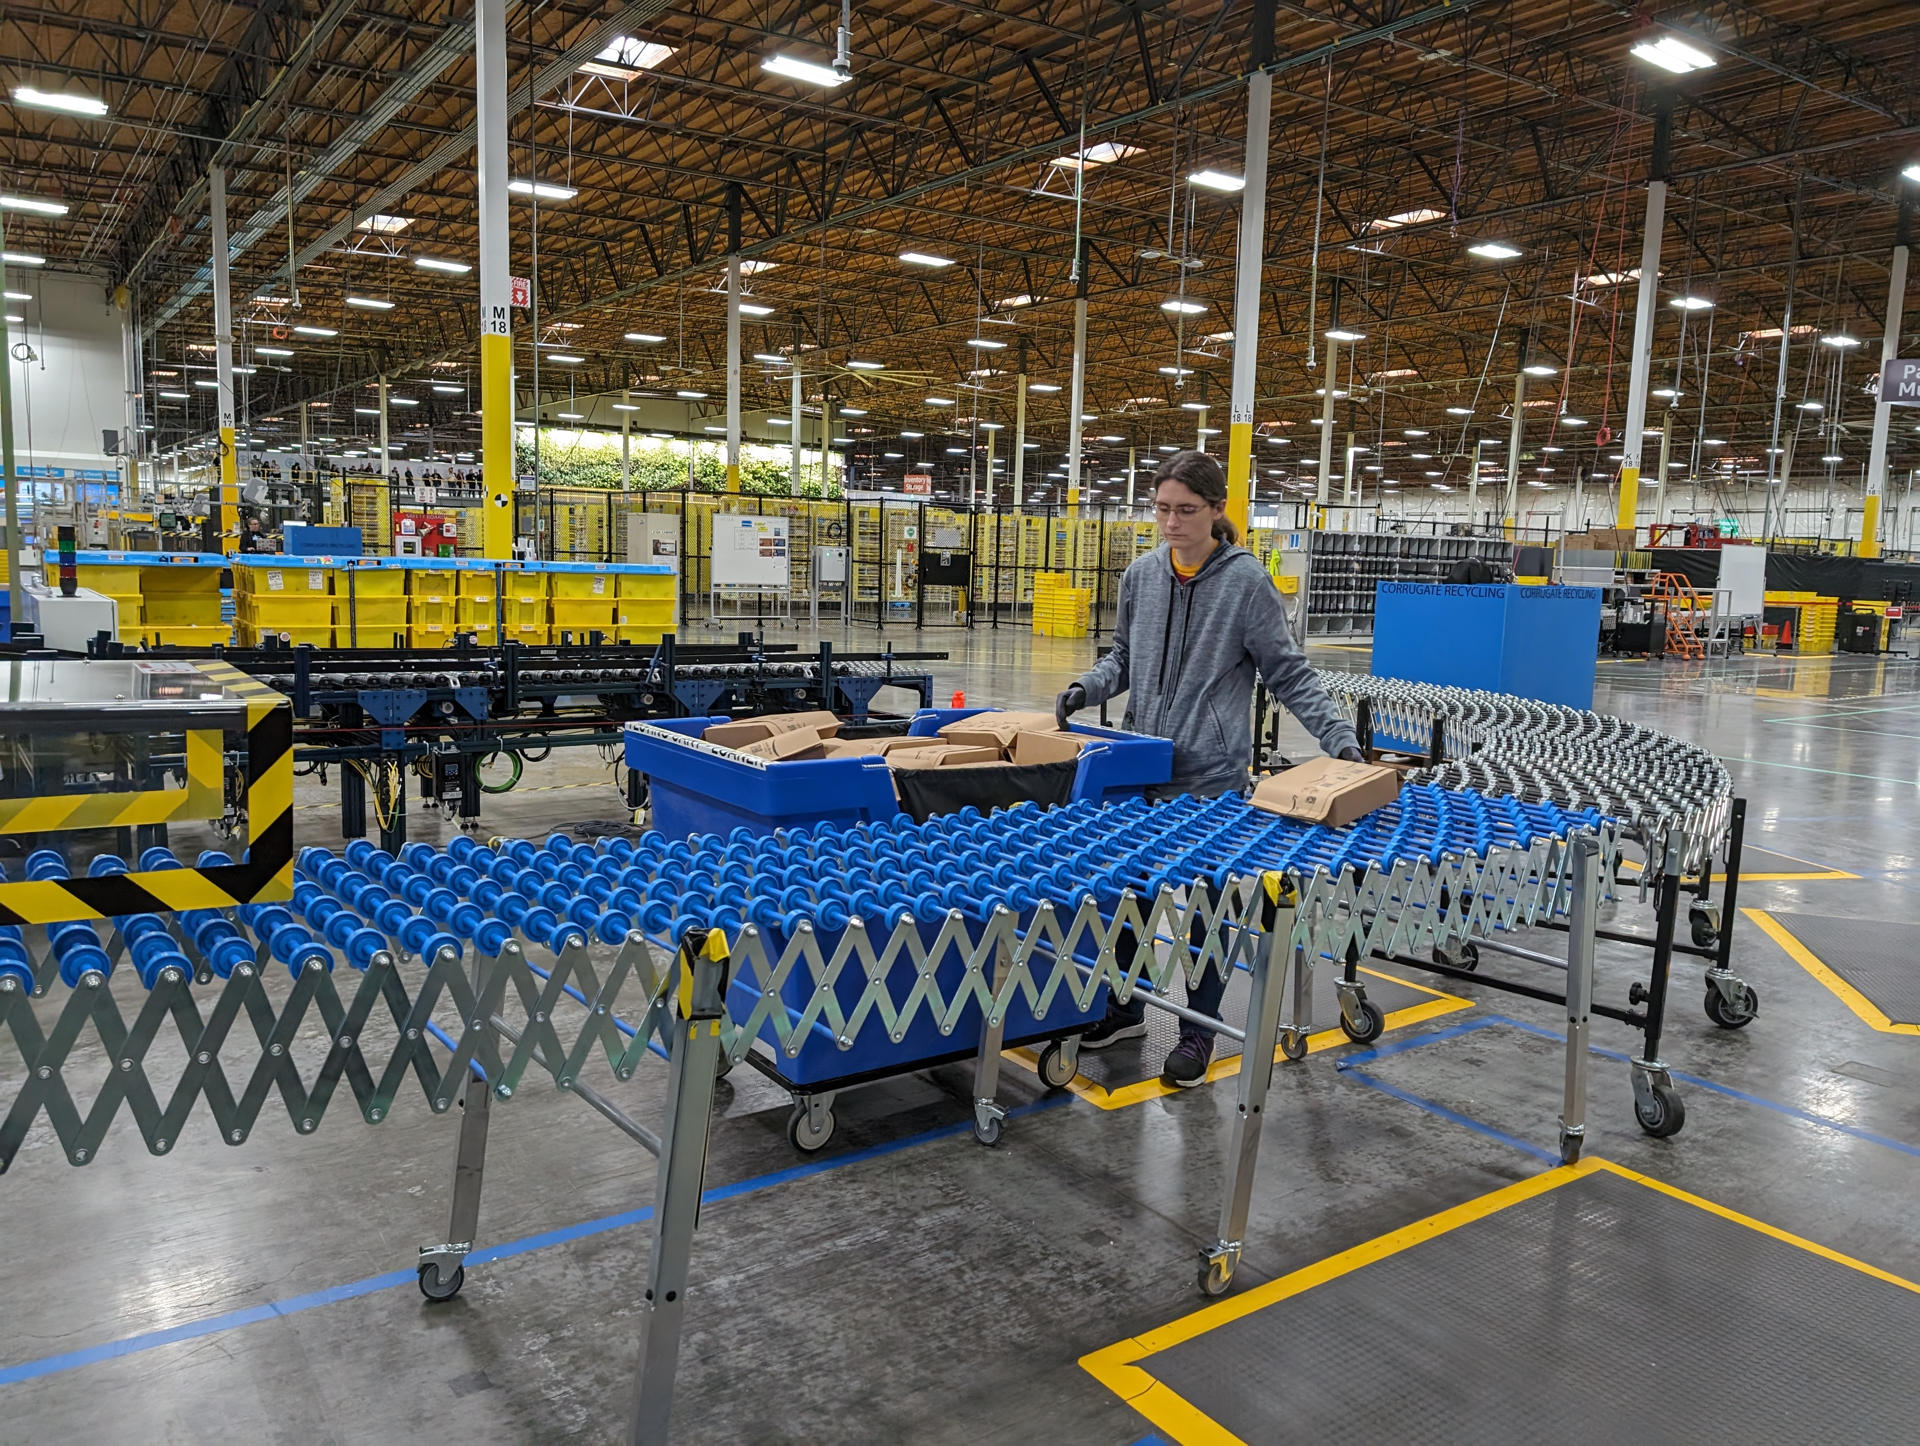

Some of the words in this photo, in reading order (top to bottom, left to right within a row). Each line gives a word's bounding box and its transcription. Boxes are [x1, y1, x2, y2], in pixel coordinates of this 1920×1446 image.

[493, 306, 505, 320] M
[491, 320, 507, 334] 18
[1234, 404, 1239, 413] L
[1245, 404, 1250, 413] L
[223, 412, 232, 420] M
[1232, 413, 1241, 422] 18
[1244, 414, 1252, 423] 18
[1381, 582, 1442, 596] CORRUGATE
[1444, 585, 1505, 599] RECYCLING
[1520, 587, 1562, 600] CORRUGATE
[1562, 588, 1596, 600] RECYCLING
